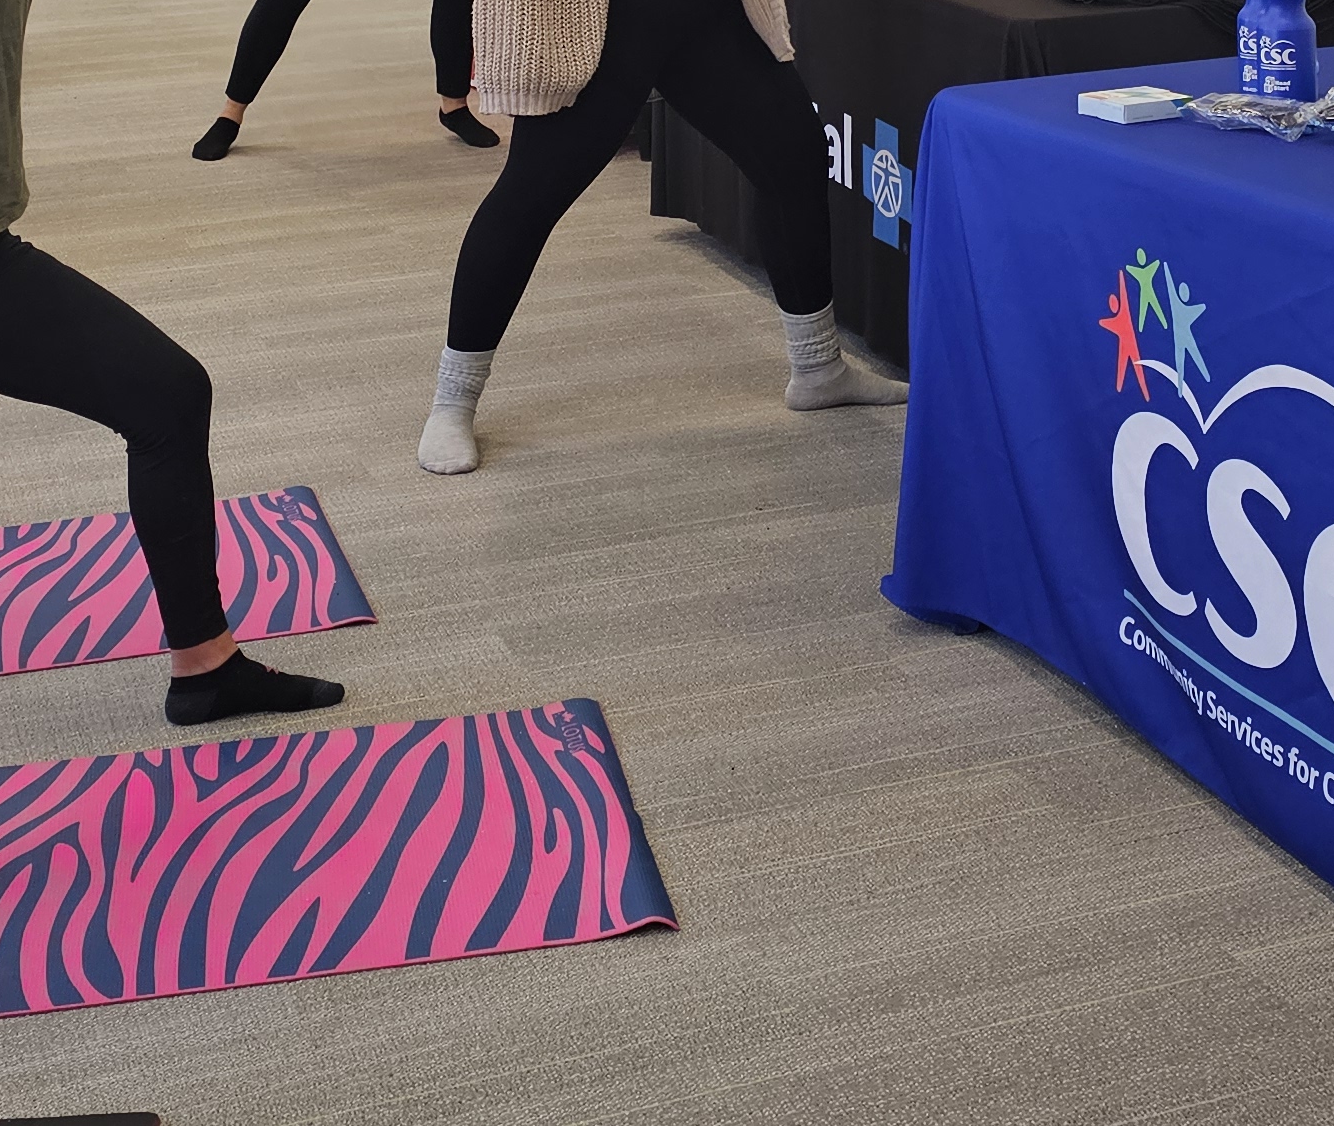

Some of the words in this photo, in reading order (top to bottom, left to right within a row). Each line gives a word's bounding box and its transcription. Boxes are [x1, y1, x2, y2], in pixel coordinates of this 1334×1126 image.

[1240, 37, 1257, 54] CS
[1261, 48, 1296, 64] CSC
[1119, 616, 1204, 715] Community
[1206, 690, 1284, 768] Services
[1288, 747, 1320, 790] for
[561, 722, 586, 753] LOTUS
